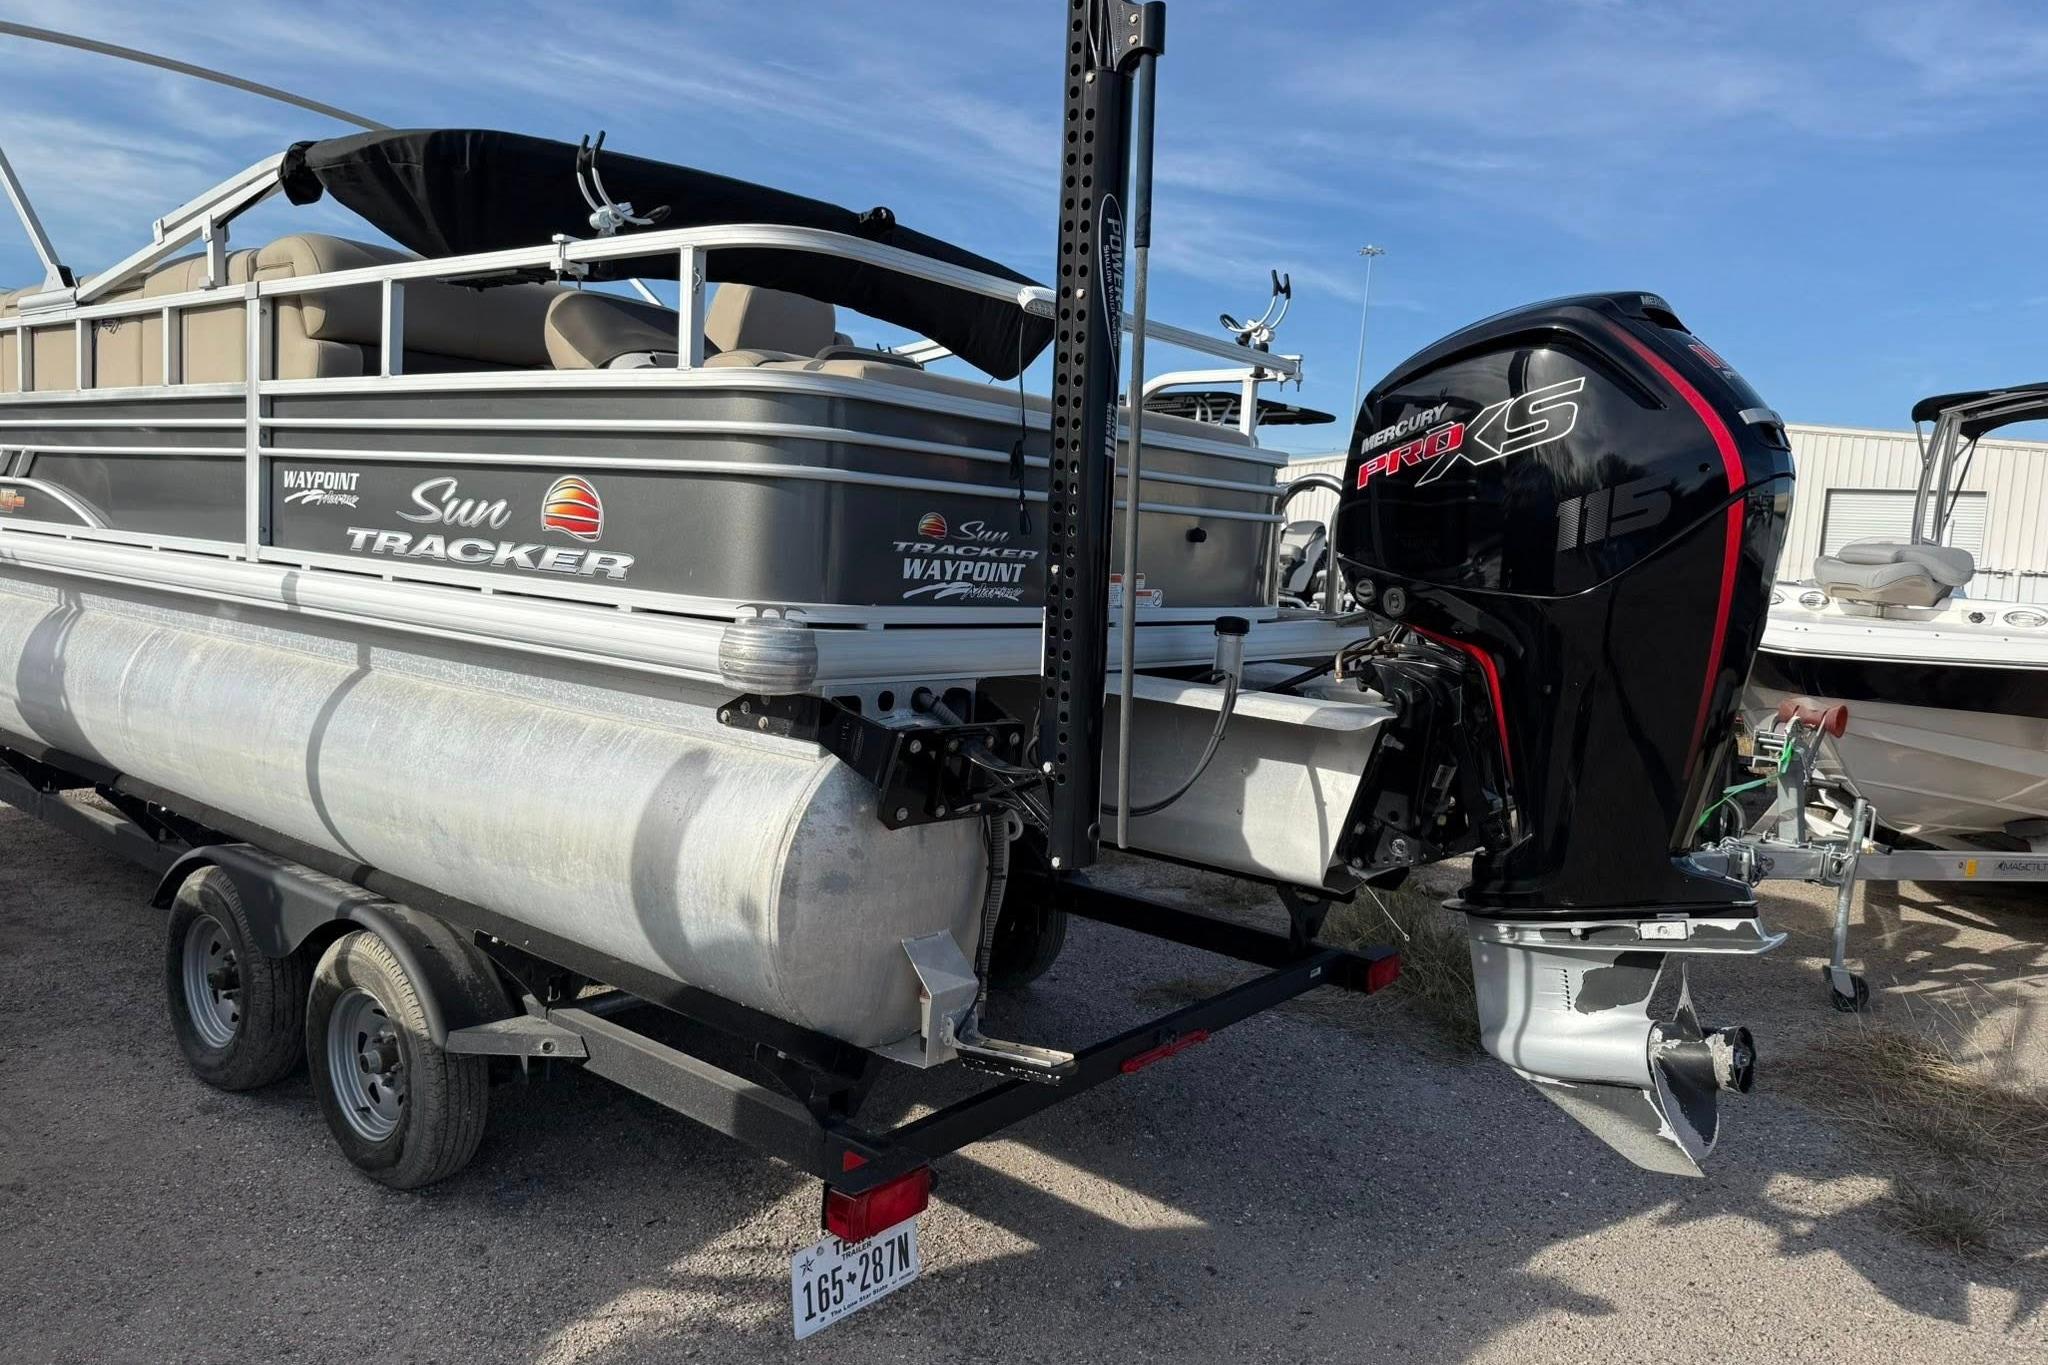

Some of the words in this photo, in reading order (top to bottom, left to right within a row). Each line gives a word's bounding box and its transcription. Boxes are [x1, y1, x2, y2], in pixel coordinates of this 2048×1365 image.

[1357, 422, 1465, 490] PRO
[1415, 376, 1586, 488] XS
[1361, 401, 1448, 454] MERCURY
[284, 470, 360, 491] WAYPOINT
[395, 475, 512, 530] Sun
[949, 520, 1009, 543] Sun
[1556, 473, 1672, 552] 115
[346, 527, 635, 581] TRACKER
[893, 541, 1039, 560] TRACKER
[903, 557, 1026, 583] WAYPOINT
[803, 1265, 844, 1322] 165
[859, 1231, 911, 1292] 287N
[842, 1240, 872, 1261] TRAILER
